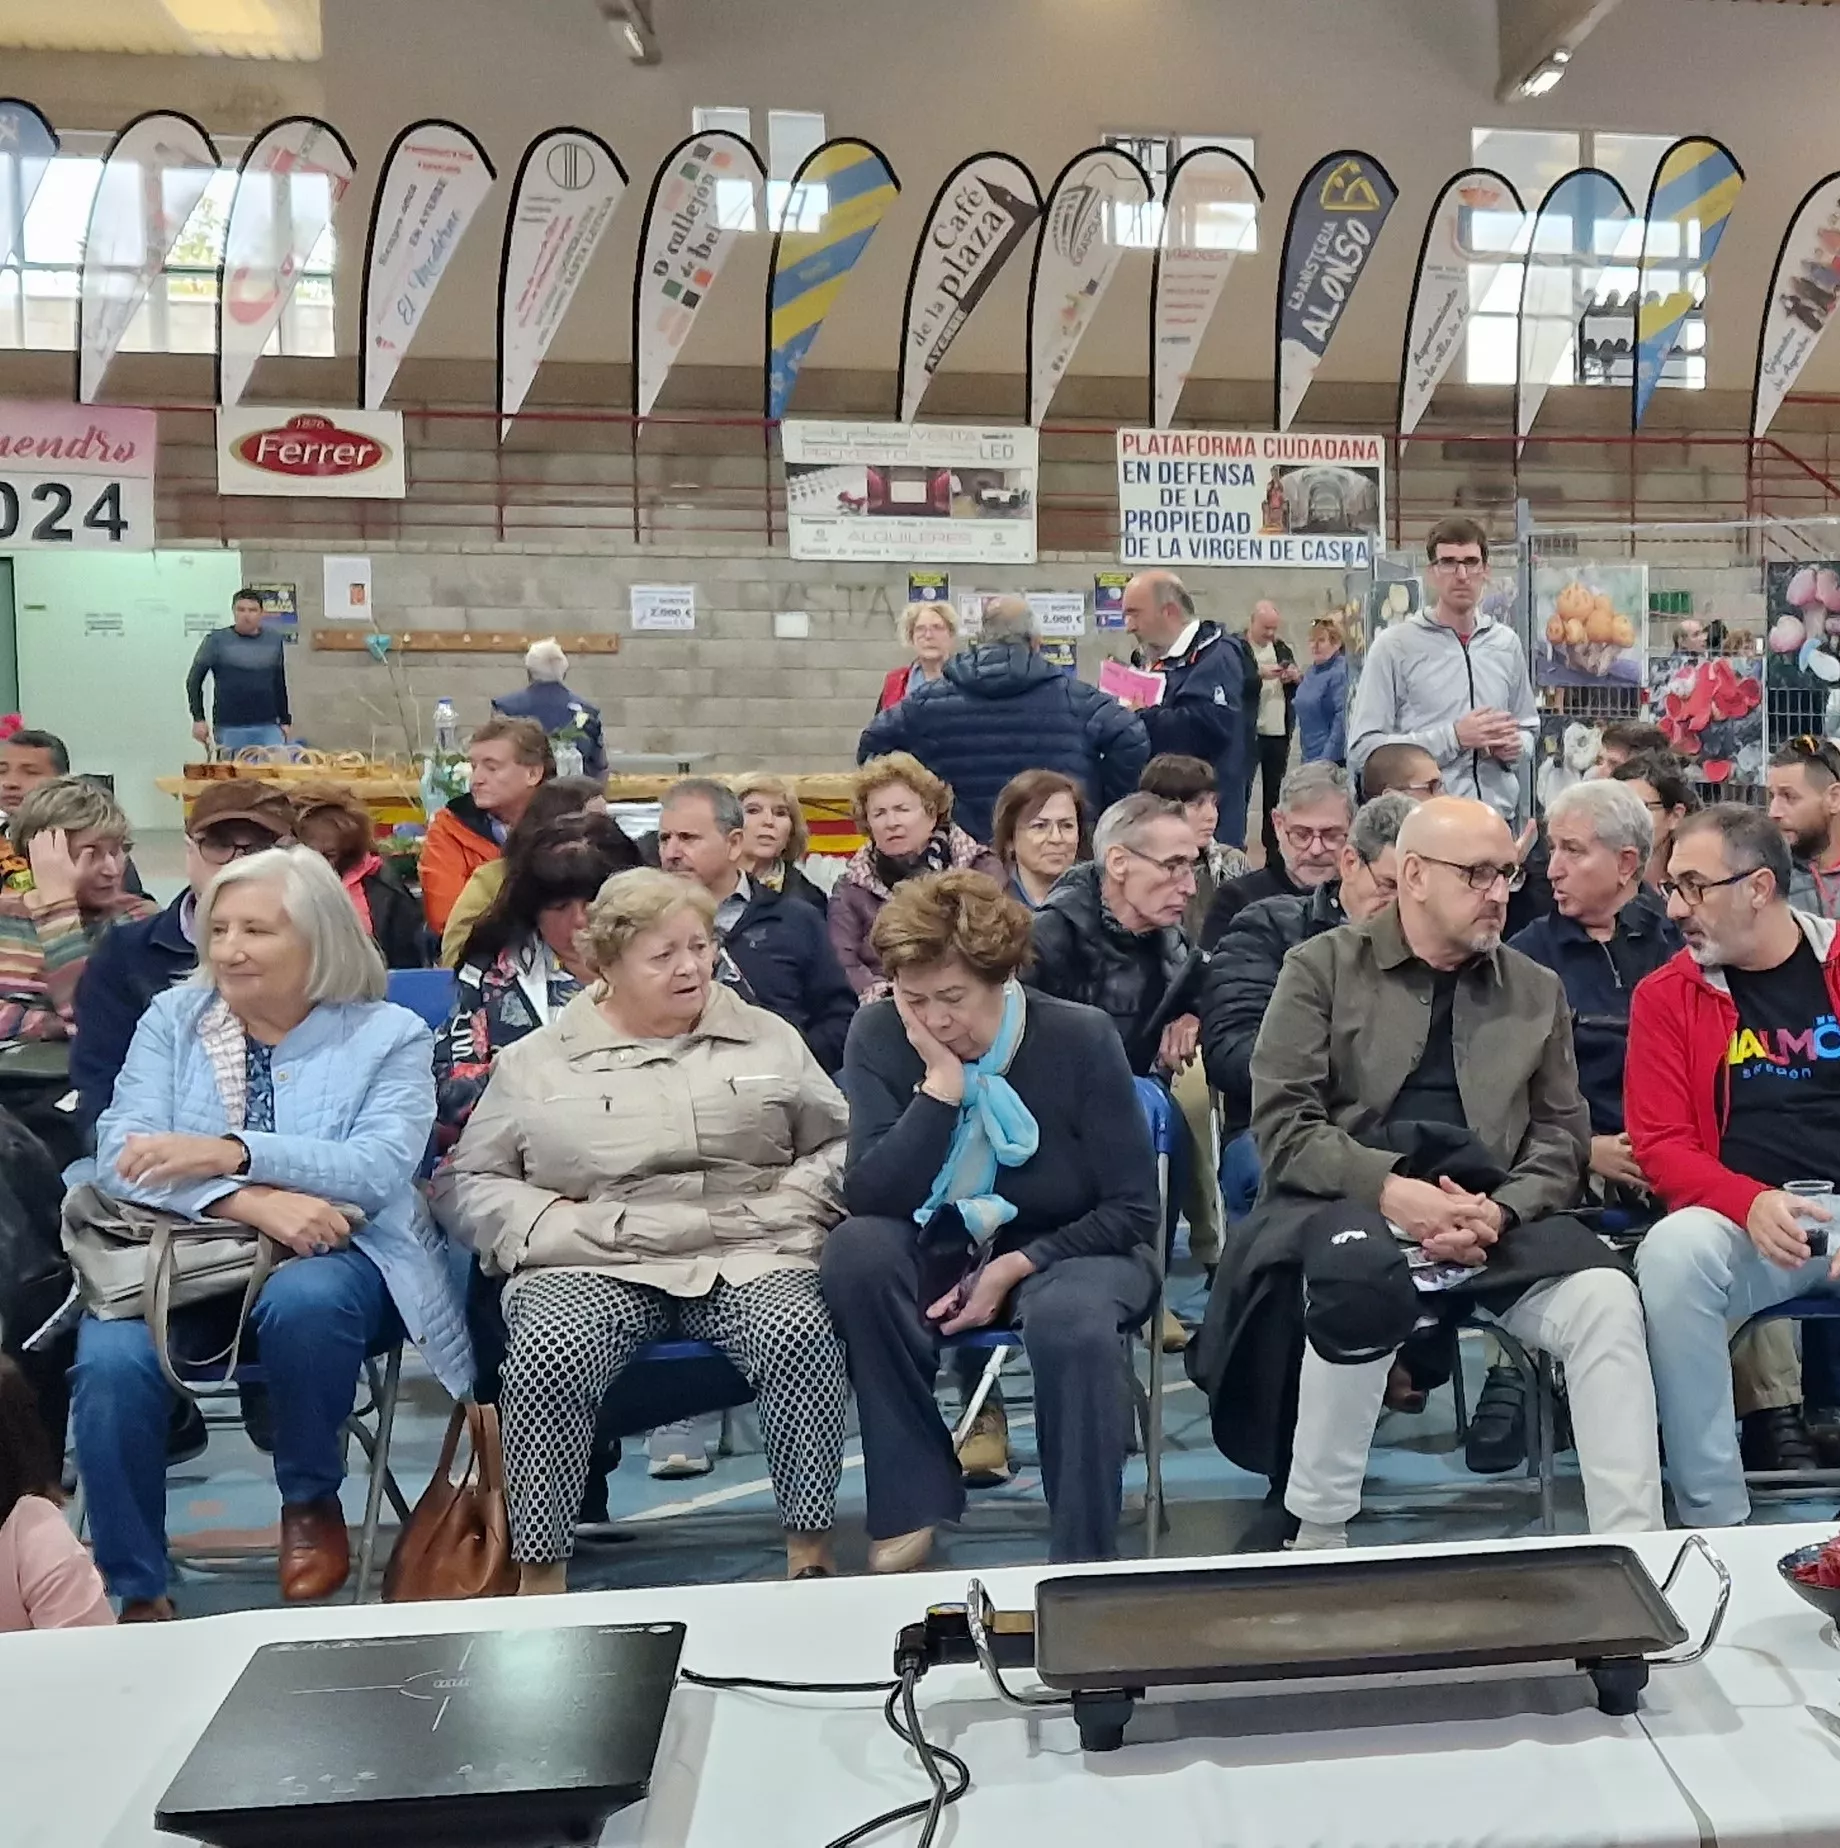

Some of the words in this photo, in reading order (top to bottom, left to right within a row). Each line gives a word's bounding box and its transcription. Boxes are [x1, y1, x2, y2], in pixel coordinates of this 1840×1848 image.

[932, 185, 983, 250] Café
[911, 322, 932, 347] de
[925, 300, 945, 320] la
[937, 209, 1007, 303] plaza
[1301, 218, 1372, 342] ALONSO
[255, 432, 374, 467] Ferrer
[979, 443, 1015, 460] LED
[1122, 433, 1257, 459] PLATAFORMA
[1263, 437, 1380, 461] CIUDADANA
[1123, 461, 1151, 485] EN
[1158, 461, 1256, 487] DEFENSA
[1160, 488, 1185, 508] DE
[1194, 488, 1220, 508] LA
[1124, 509, 1251, 535] PROPIEDAD
[847, 529, 972, 545] ALQUILERES
[1124, 537, 1151, 559] DE
[1157, 537, 1182, 559] LA
[1189, 538, 1262, 561] VIRGEN
[1269, 540, 1295, 562] DE
